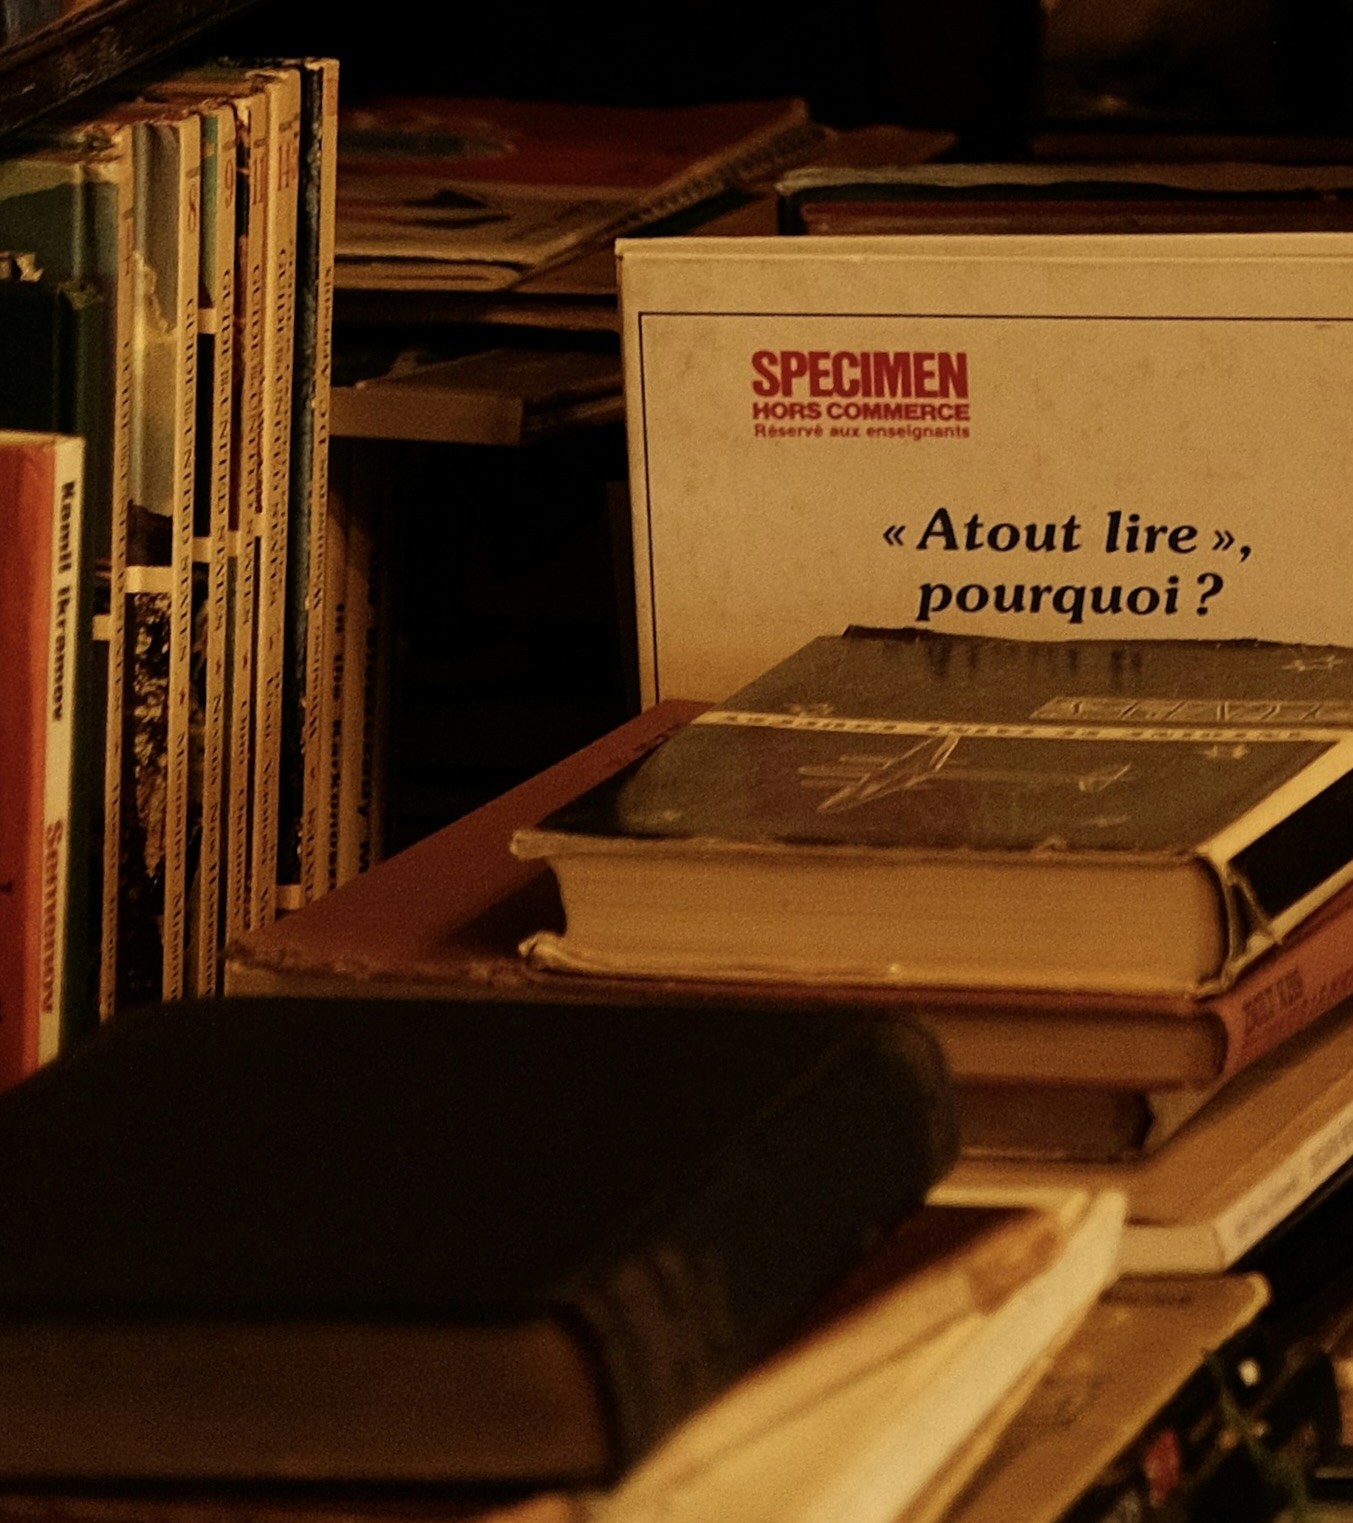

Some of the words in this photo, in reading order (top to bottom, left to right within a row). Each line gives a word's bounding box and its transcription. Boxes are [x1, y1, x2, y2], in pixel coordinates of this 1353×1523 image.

[751, 349, 969, 399] SPECIMEN
[752, 401, 821, 420] HORS
[826, 402, 970, 421] COMMERCE
[754, 422, 824, 439] Réservé
[830, 426, 860, 438] aux
[865, 424, 971, 442] enseignants
[58, 479, 75, 575] Kamil
[1104, 508, 1198, 555] lire
[915, 573, 1180, 623] pourquoi
